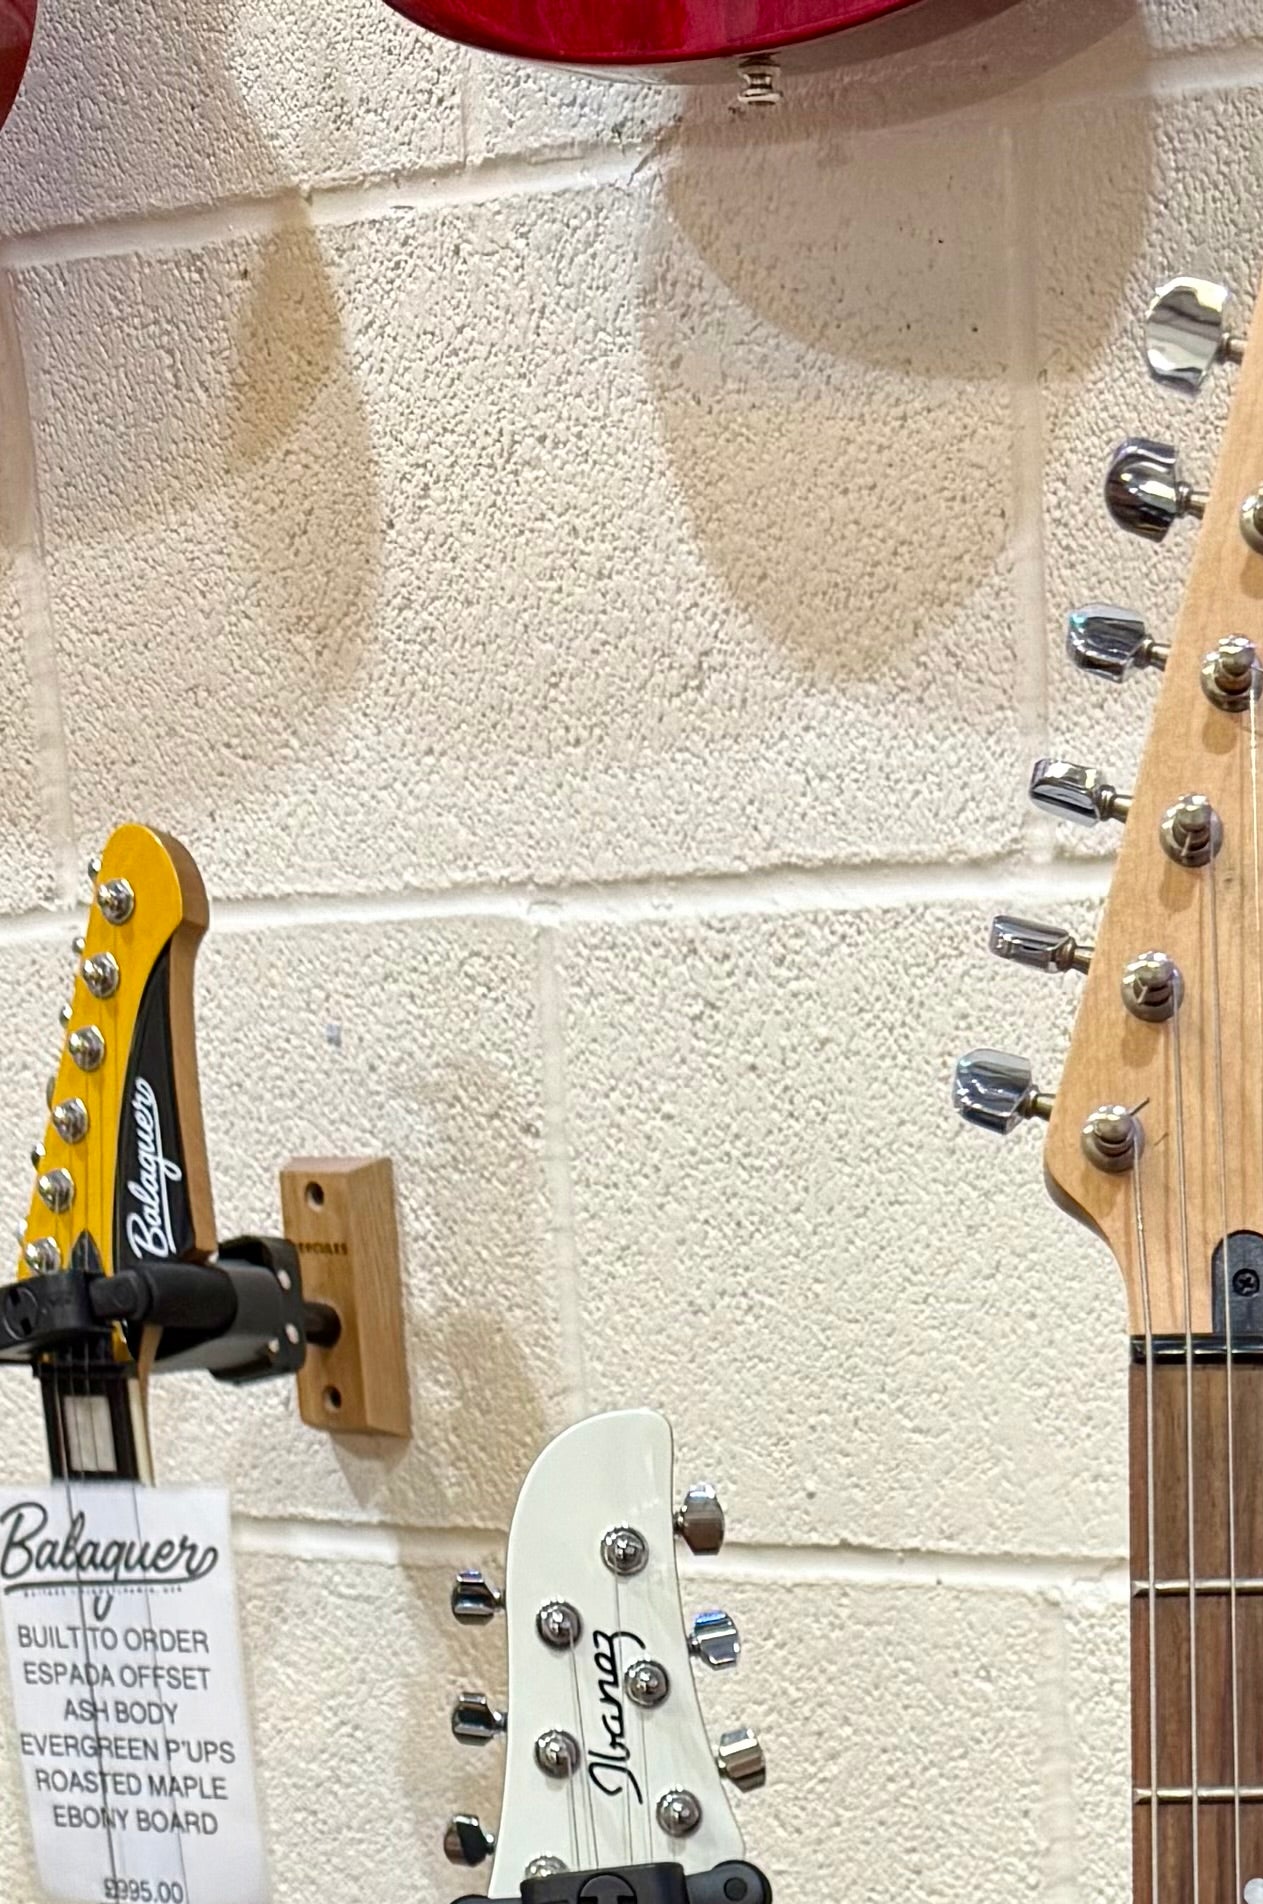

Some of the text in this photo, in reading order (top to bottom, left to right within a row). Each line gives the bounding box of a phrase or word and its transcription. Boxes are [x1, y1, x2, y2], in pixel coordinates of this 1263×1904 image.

[126, 1075, 182, 1261] Balaguer
[0, 1502, 218, 1621] Balaguer
[18, 1623, 210, 1654] BUILT TO ORDER
[23, 1661, 211, 1690] ESPADA OFFSET
[64, 1698, 179, 1726] ASH BODY
[20, 1733, 160, 1762] EVERGREEN
[36, 1768, 228, 1801] ROASTED MAPLE
[53, 1804, 219, 1836] EBONY BOARD
